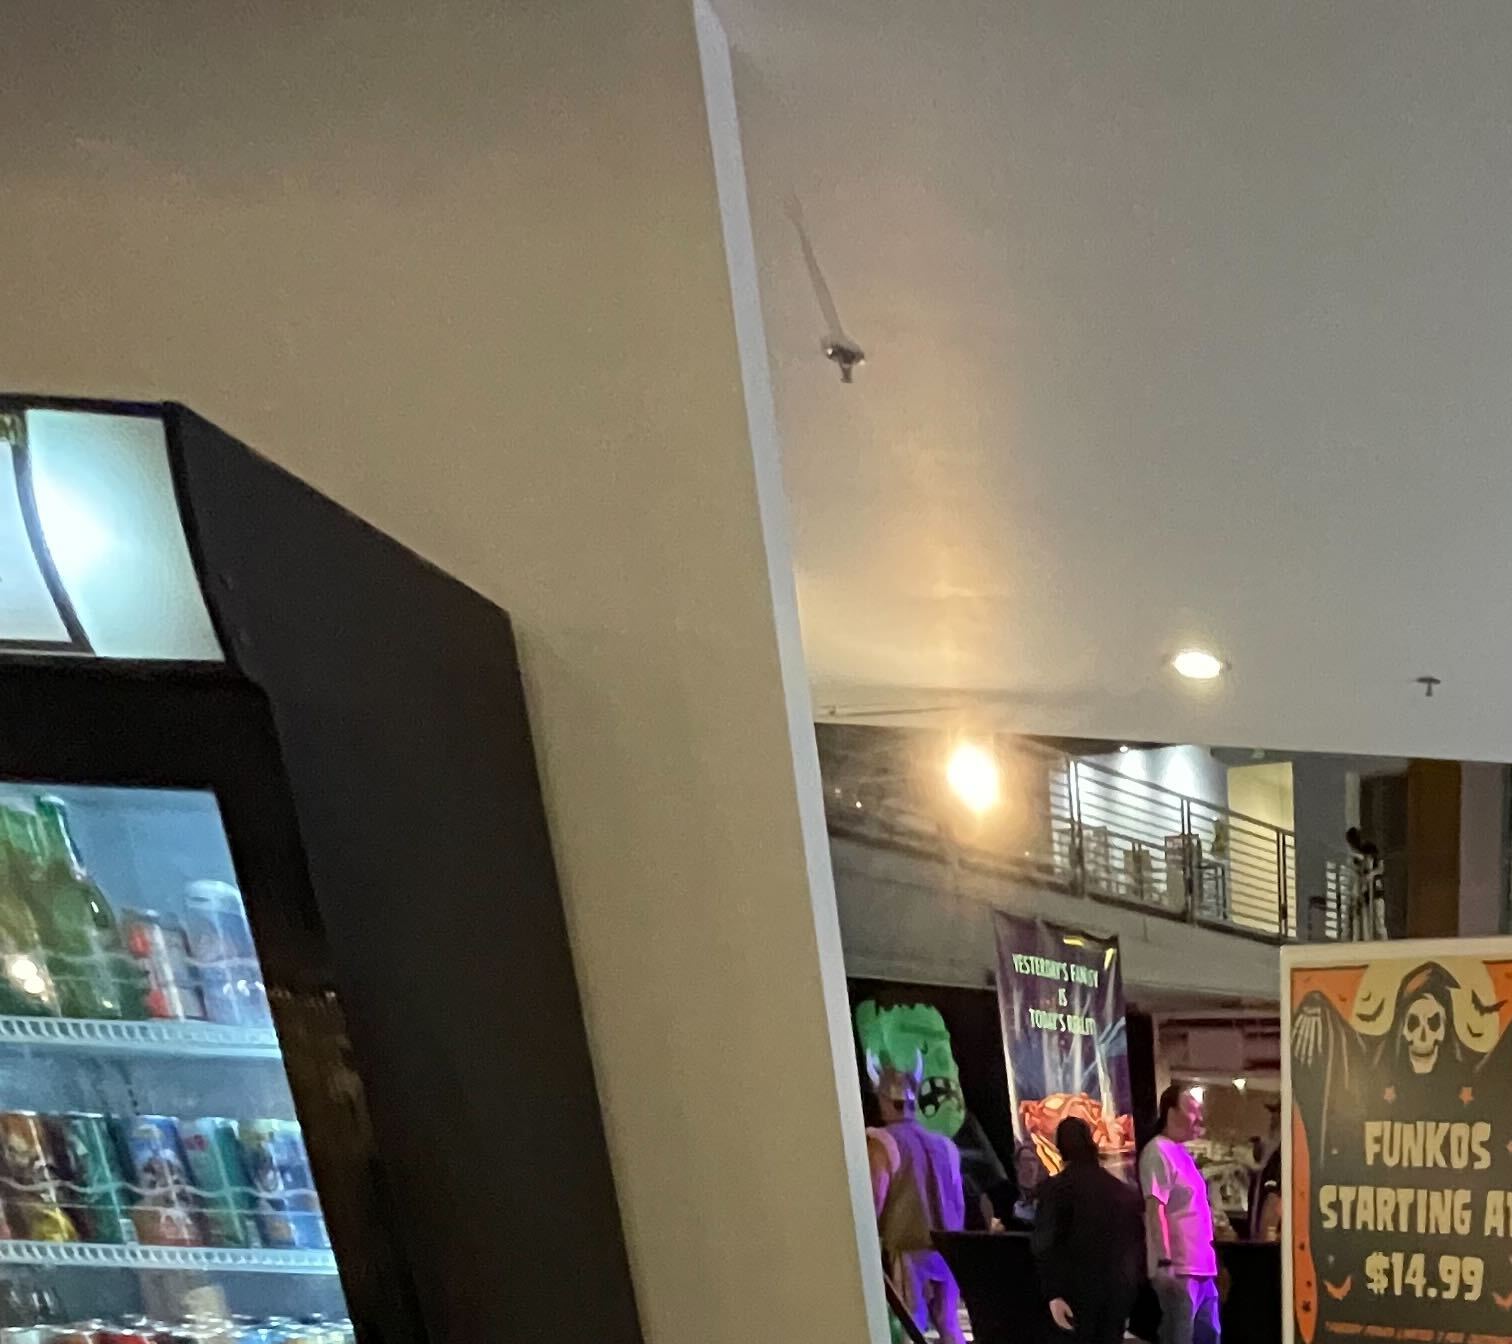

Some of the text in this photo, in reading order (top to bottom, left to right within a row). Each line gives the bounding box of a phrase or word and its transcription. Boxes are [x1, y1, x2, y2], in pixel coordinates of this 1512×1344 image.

[1364, 1121, 1491, 1170] FUNKOS
[1319, 1184, 1472, 1236] STARTING
[1365, 1251, 1485, 1301] $14.99
